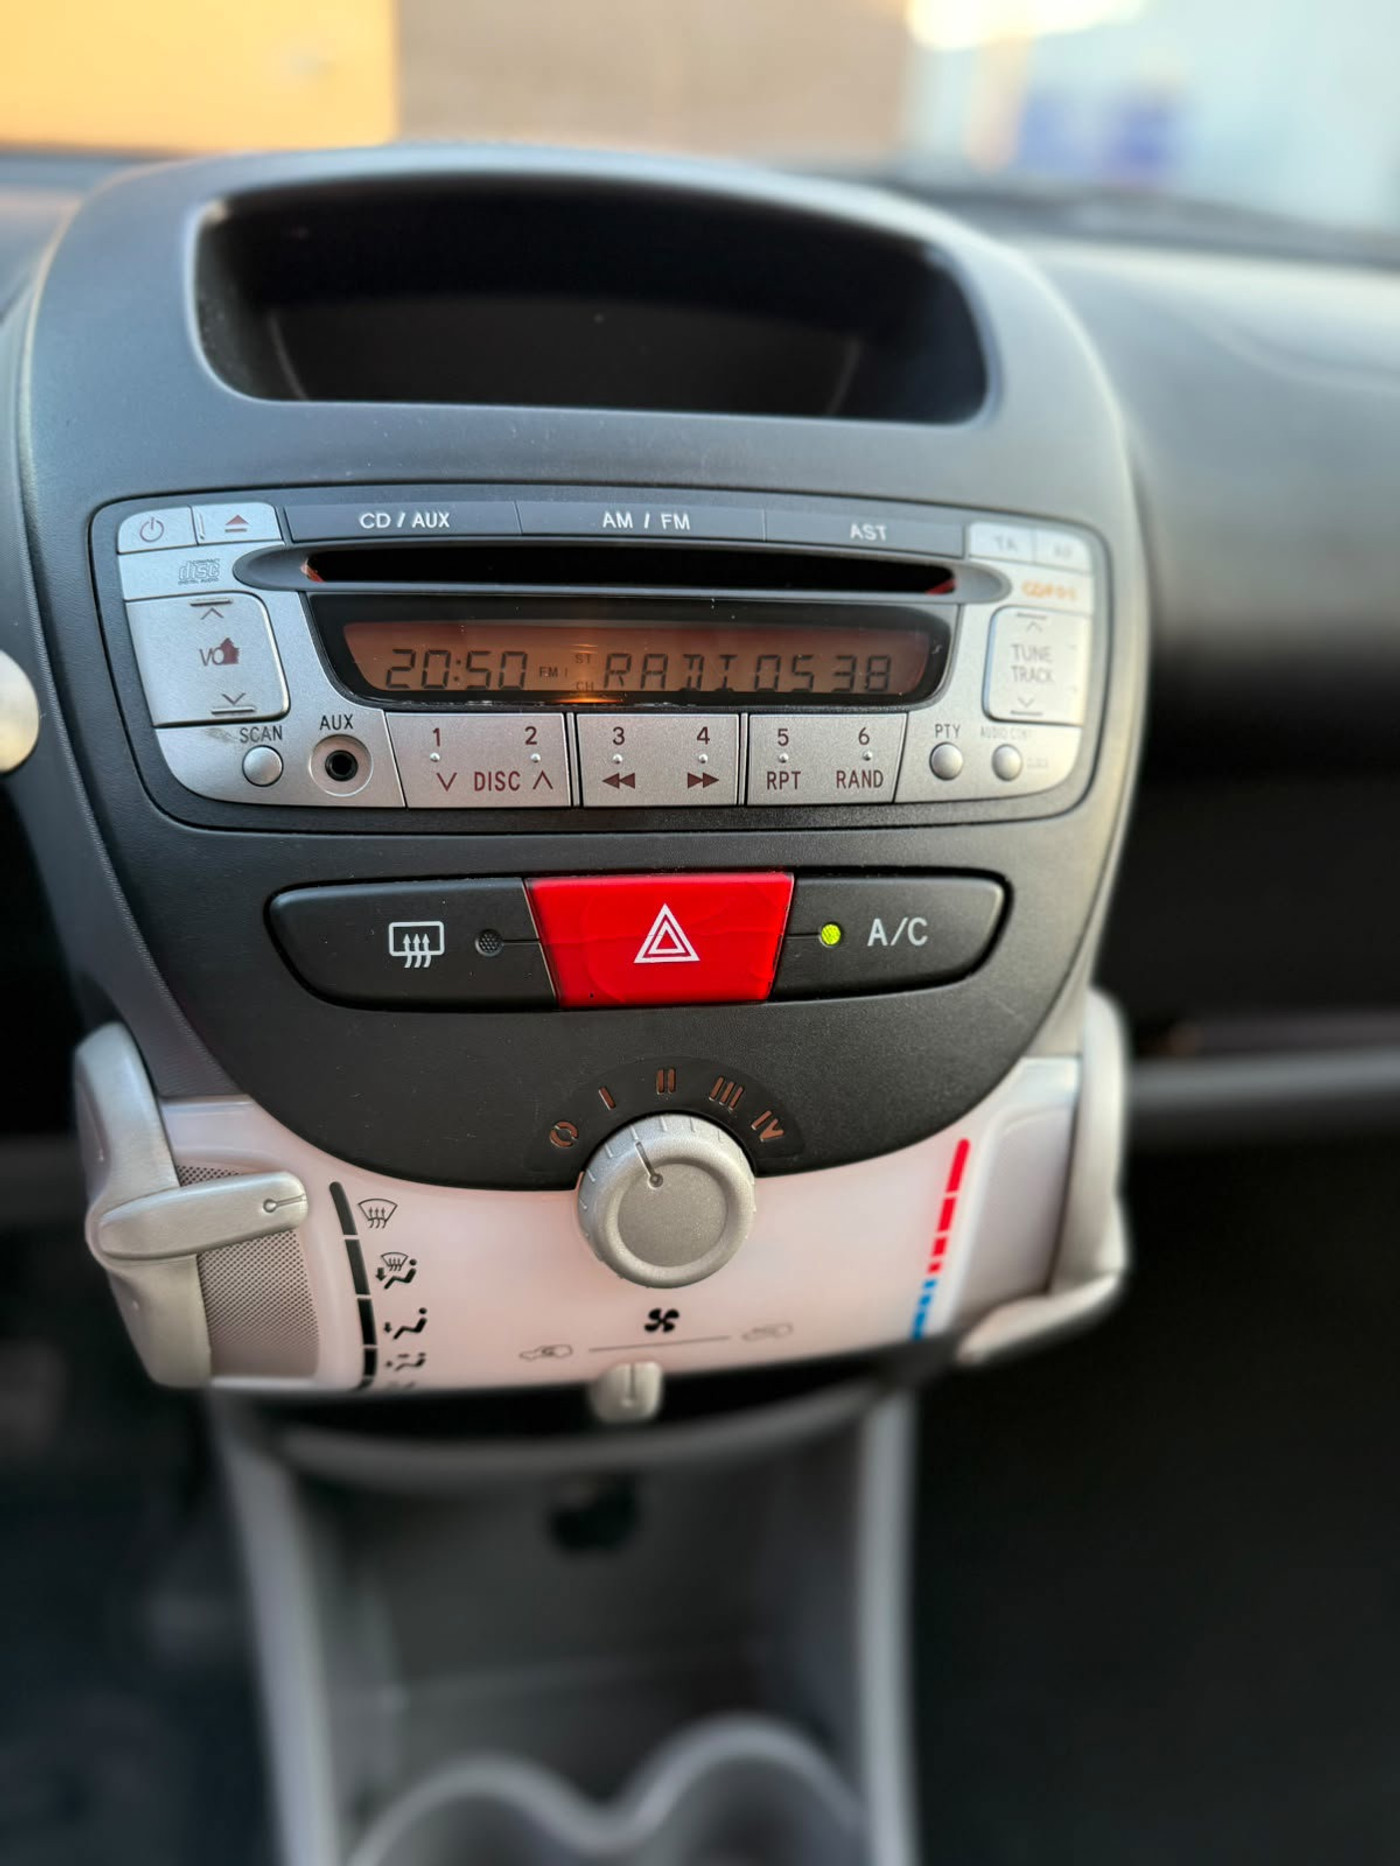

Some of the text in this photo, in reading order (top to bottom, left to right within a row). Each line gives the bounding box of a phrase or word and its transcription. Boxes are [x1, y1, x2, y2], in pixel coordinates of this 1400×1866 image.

[359, 512, 391, 529] CD
[411, 511, 450, 529] AUX
[602, 512, 634, 529] AM
[660, 512, 691, 531] FM
[850, 523, 887, 541] AST
[1010, 643, 1053, 663] TUNE
[385, 648, 529, 690] 20:50
[539, 666, 558, 677] FM
[1010, 665, 1056, 684] TRACK
[319, 714, 354, 731] AUX
[935, 723, 961, 738] PTY
[239, 725, 283, 743] SCAN
[432, 728, 441, 747] 1
[524, 726, 538, 746] 2
[612, 726, 626, 746] 3
[696, 726, 710, 746] 4
[777, 728, 789, 746] 5
[858, 727, 870, 746] 6
[473, 771, 521, 791] DISC
[766, 770, 801, 790] RPT
[835, 769, 884, 789] RAND
[867, 917, 928, 947] A/C
